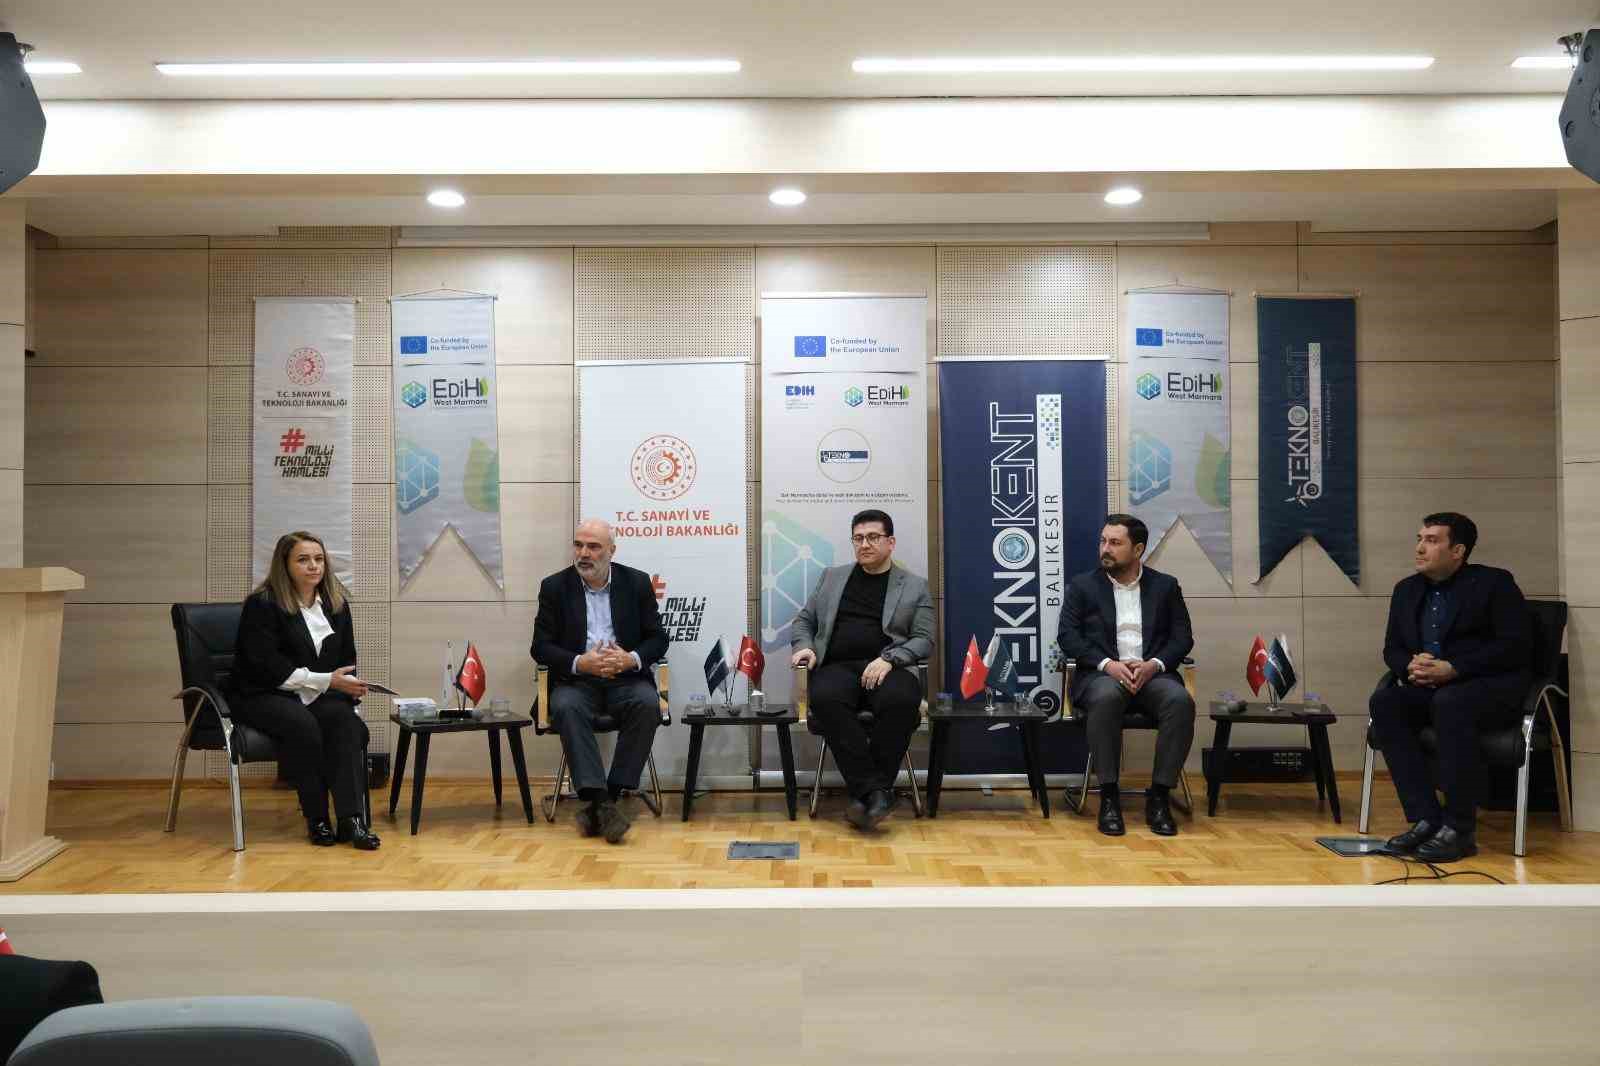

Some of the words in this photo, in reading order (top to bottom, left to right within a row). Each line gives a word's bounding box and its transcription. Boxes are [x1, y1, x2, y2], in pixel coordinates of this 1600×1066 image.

[831, 337, 867, 345] Co-funded
[868, 337, 878, 346] by
[842, 346, 877, 354] European
[321, 390, 332, 398] VE
[785, 385, 815, 396] EDIH
[454, 398, 488, 406] Marmara
[1167, 392, 1186, 400] West
[1188, 392, 1222, 401] Marmara
[615, 511, 639, 521] T.C.
[641, 508, 689, 521] SANAYİ
[692, 510, 711, 520] VE
[609, 524, 663, 537] NOLOJİ
[666, 523, 740, 537] BAKANLIĞI
[990, 401, 1038, 695] EKNOKENT
[1042, 494, 1060, 607] BALIKESİR
[659, 612, 704, 627] OLOJİ
